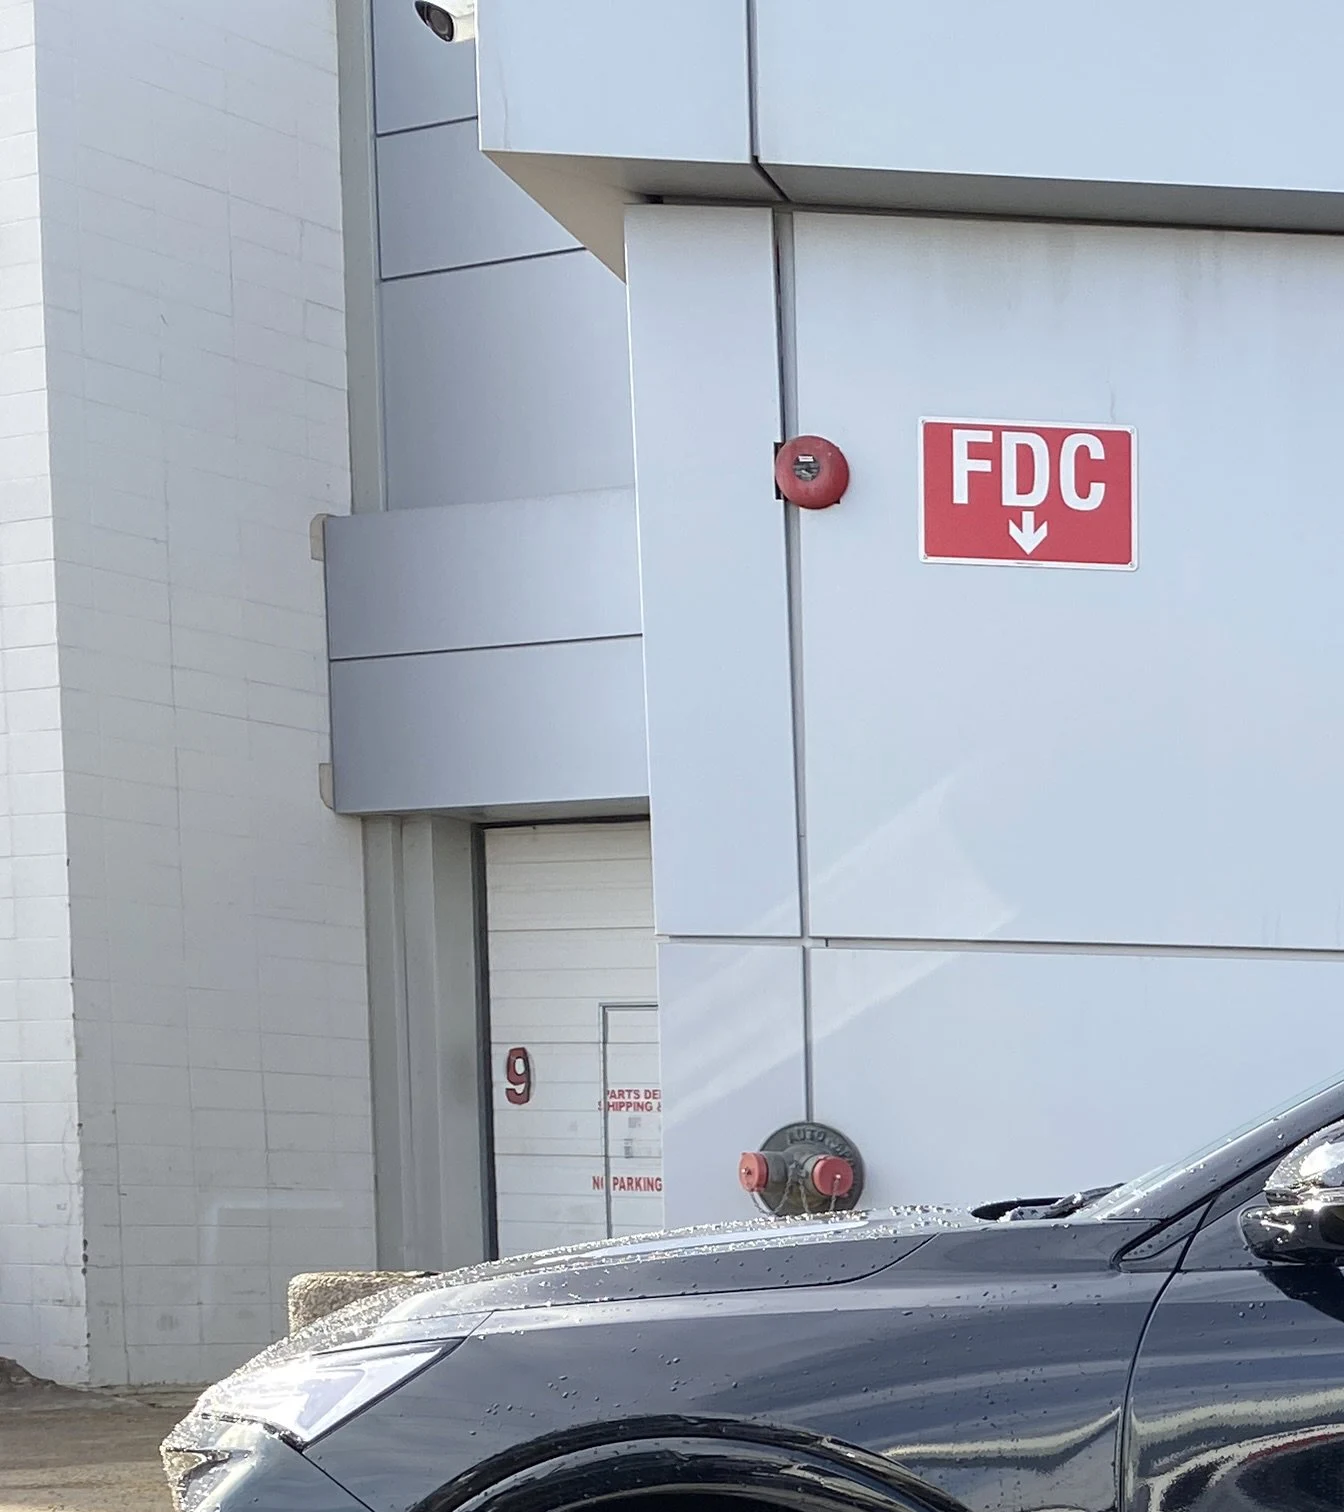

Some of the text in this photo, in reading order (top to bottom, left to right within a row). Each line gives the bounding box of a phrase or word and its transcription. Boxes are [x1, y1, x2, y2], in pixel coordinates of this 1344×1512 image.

[952, 428, 1106, 511] FDC
[505, 1046, 531, 1106] 9
[644, 1089, 661, 1100] DE
[612, 1176, 663, 1192] PARKING
